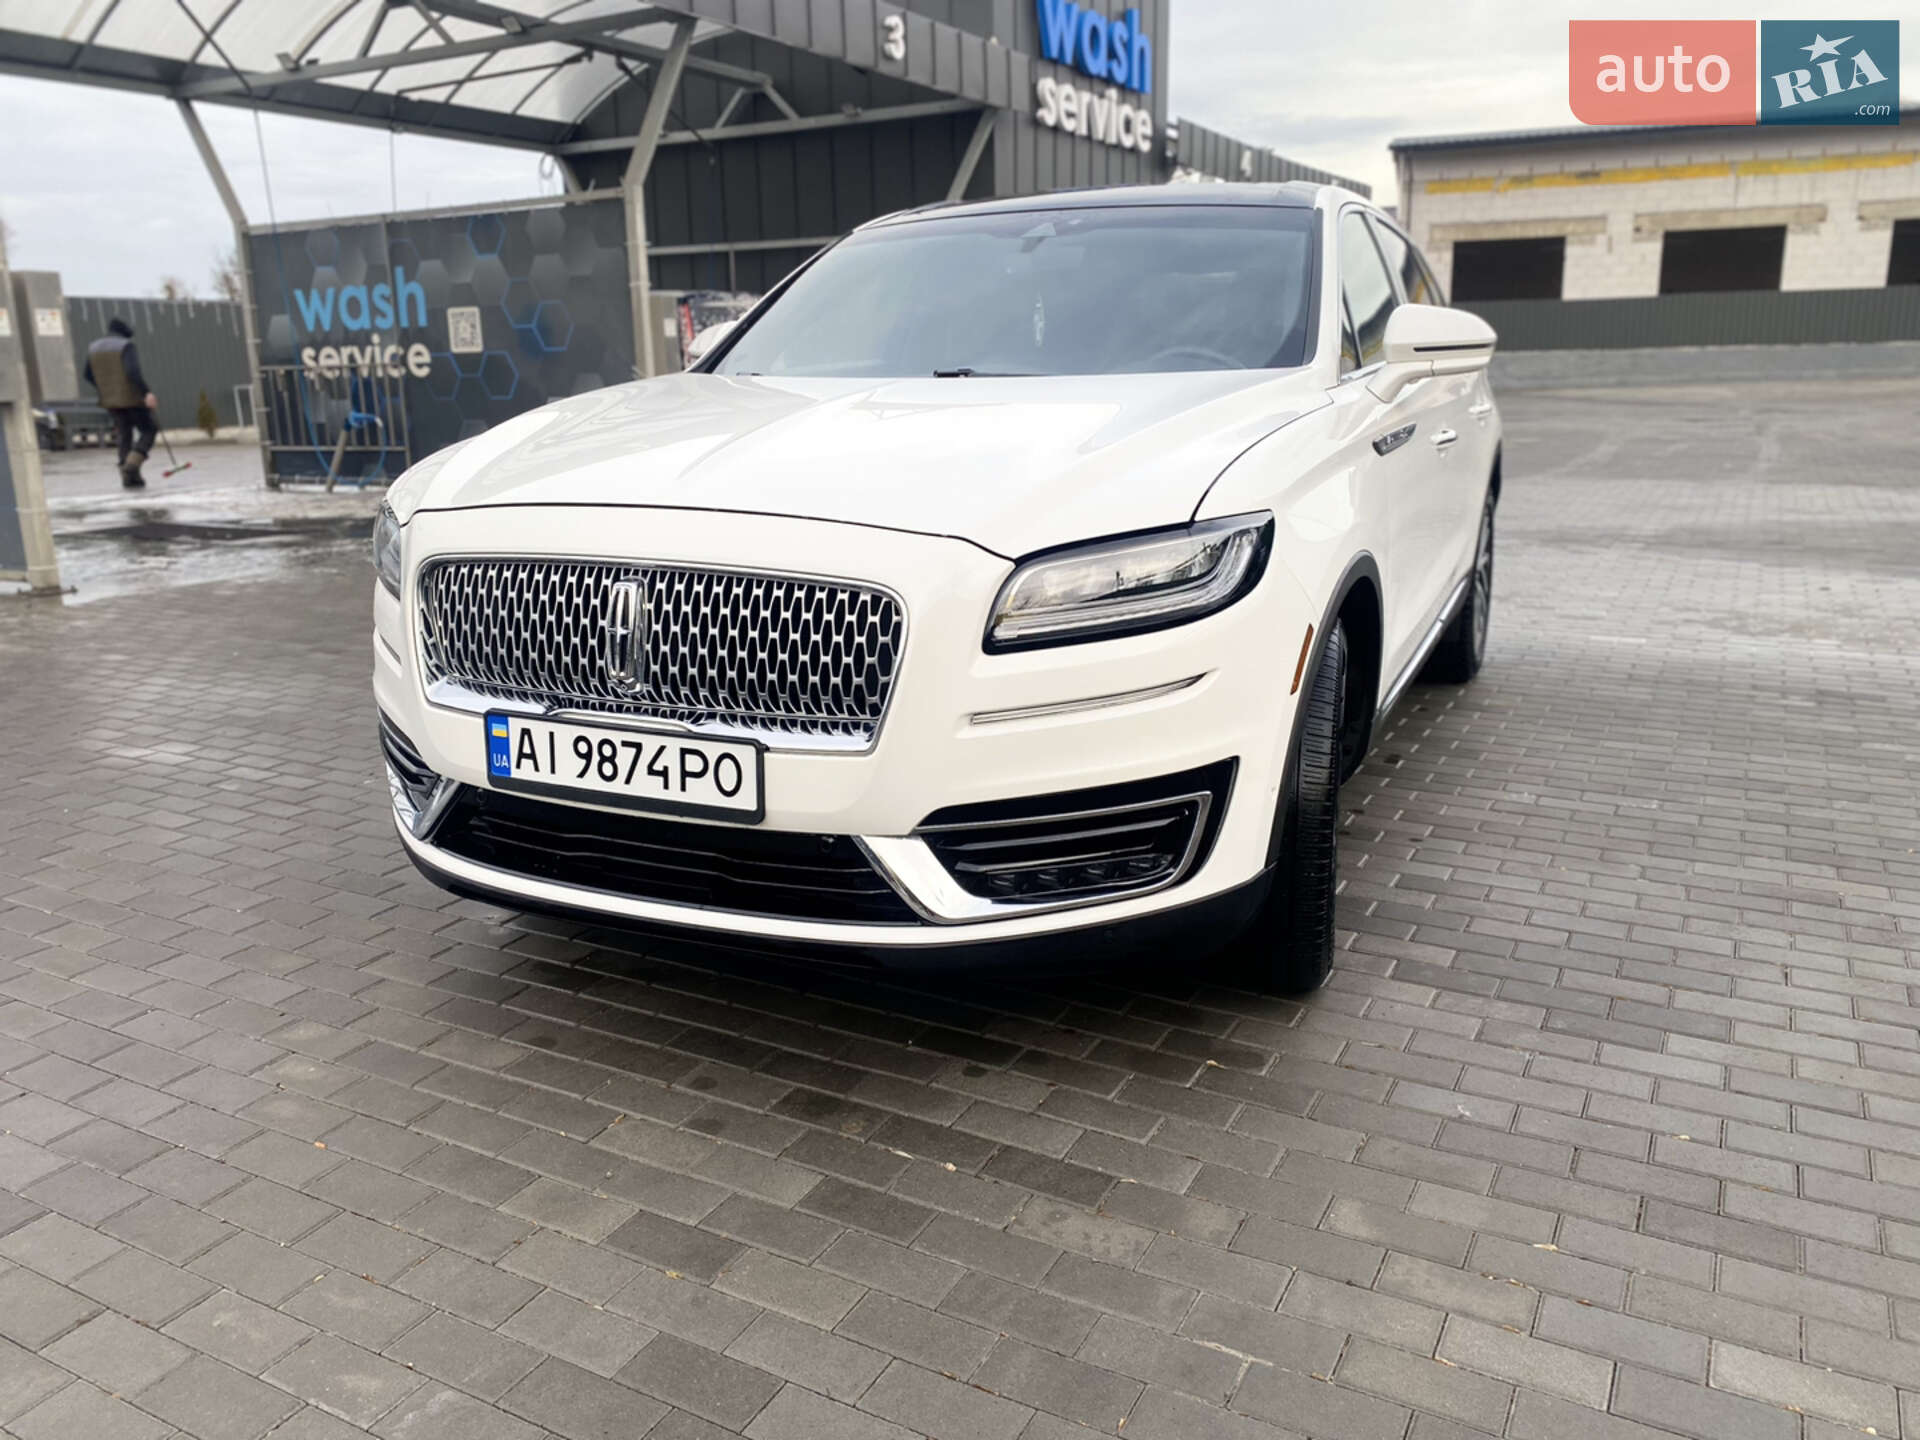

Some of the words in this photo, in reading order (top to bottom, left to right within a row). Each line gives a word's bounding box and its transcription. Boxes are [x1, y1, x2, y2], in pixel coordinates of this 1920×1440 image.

[883, 14, 906, 60] 3
[1036, 0, 1152, 95] wash
[1036, 76, 1153, 153] service
[293, 265, 428, 333] wash
[302, 332, 433, 380] service
[493, 752, 511, 769] UA
[514, 727, 556, 775] AI
